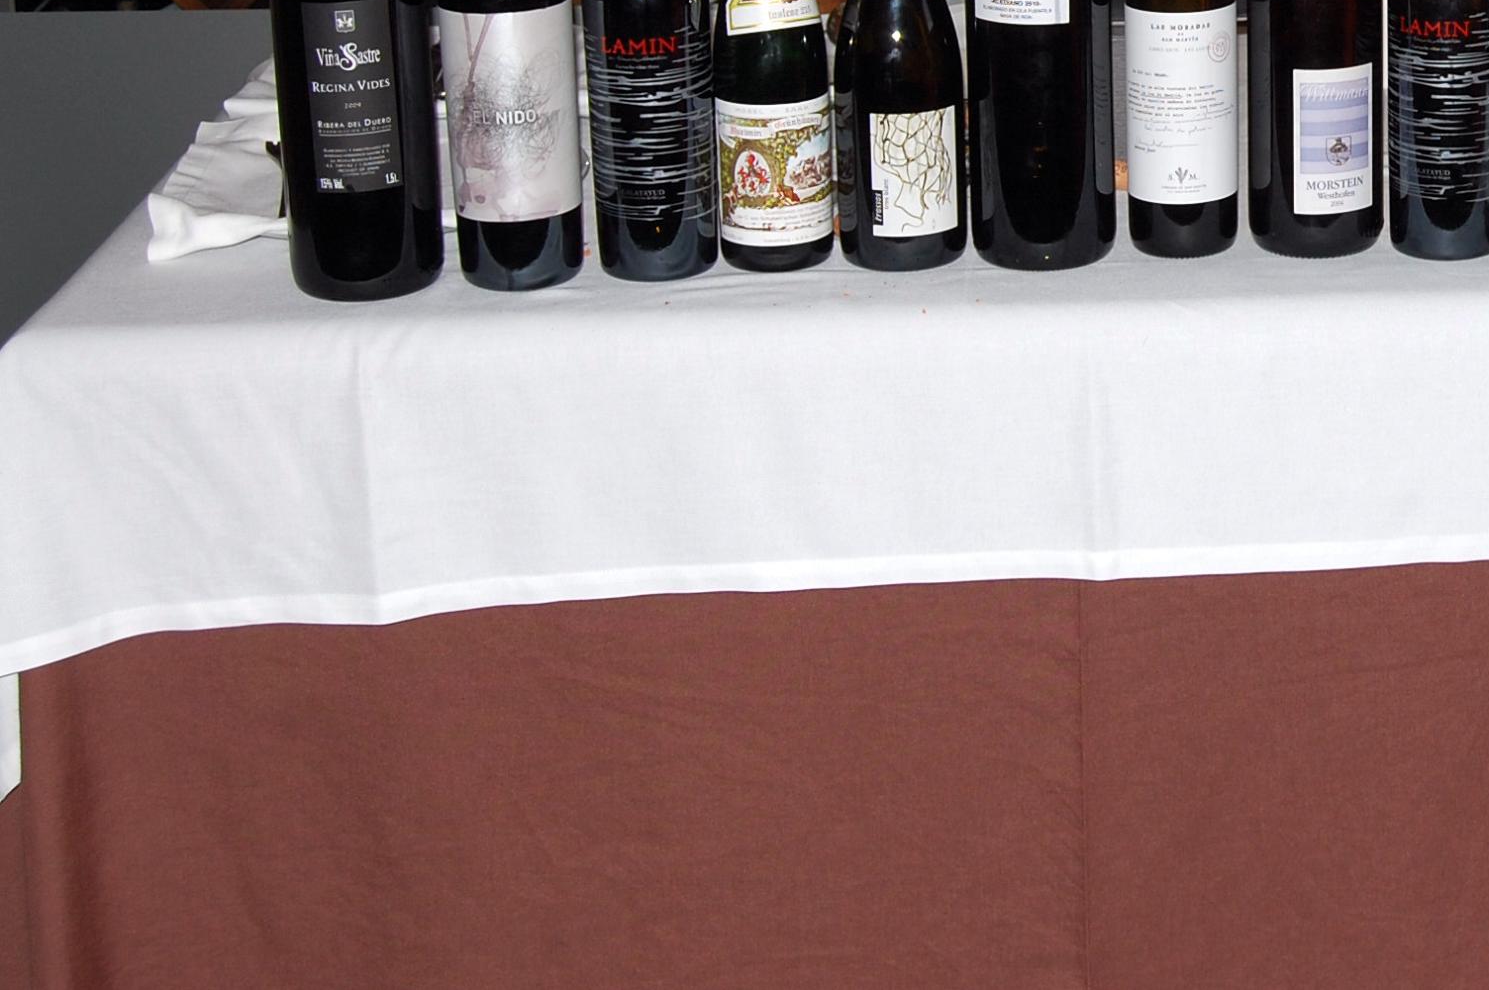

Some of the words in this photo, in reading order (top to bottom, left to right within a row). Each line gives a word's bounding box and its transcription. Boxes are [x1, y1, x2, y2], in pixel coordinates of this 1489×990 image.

[1400, 16, 1471, 38] LAMIN
[601, 36, 676, 55] LAMIN
[312, 81, 355, 93] REGINA
[357, 78, 391, 91] VIDES
[317, 120, 345, 129] RIBERA
[364, 117, 391, 127] DUERO
[495, 110, 537, 126] NIDO
[1306, 174, 1364, 191] MORSTEIN
